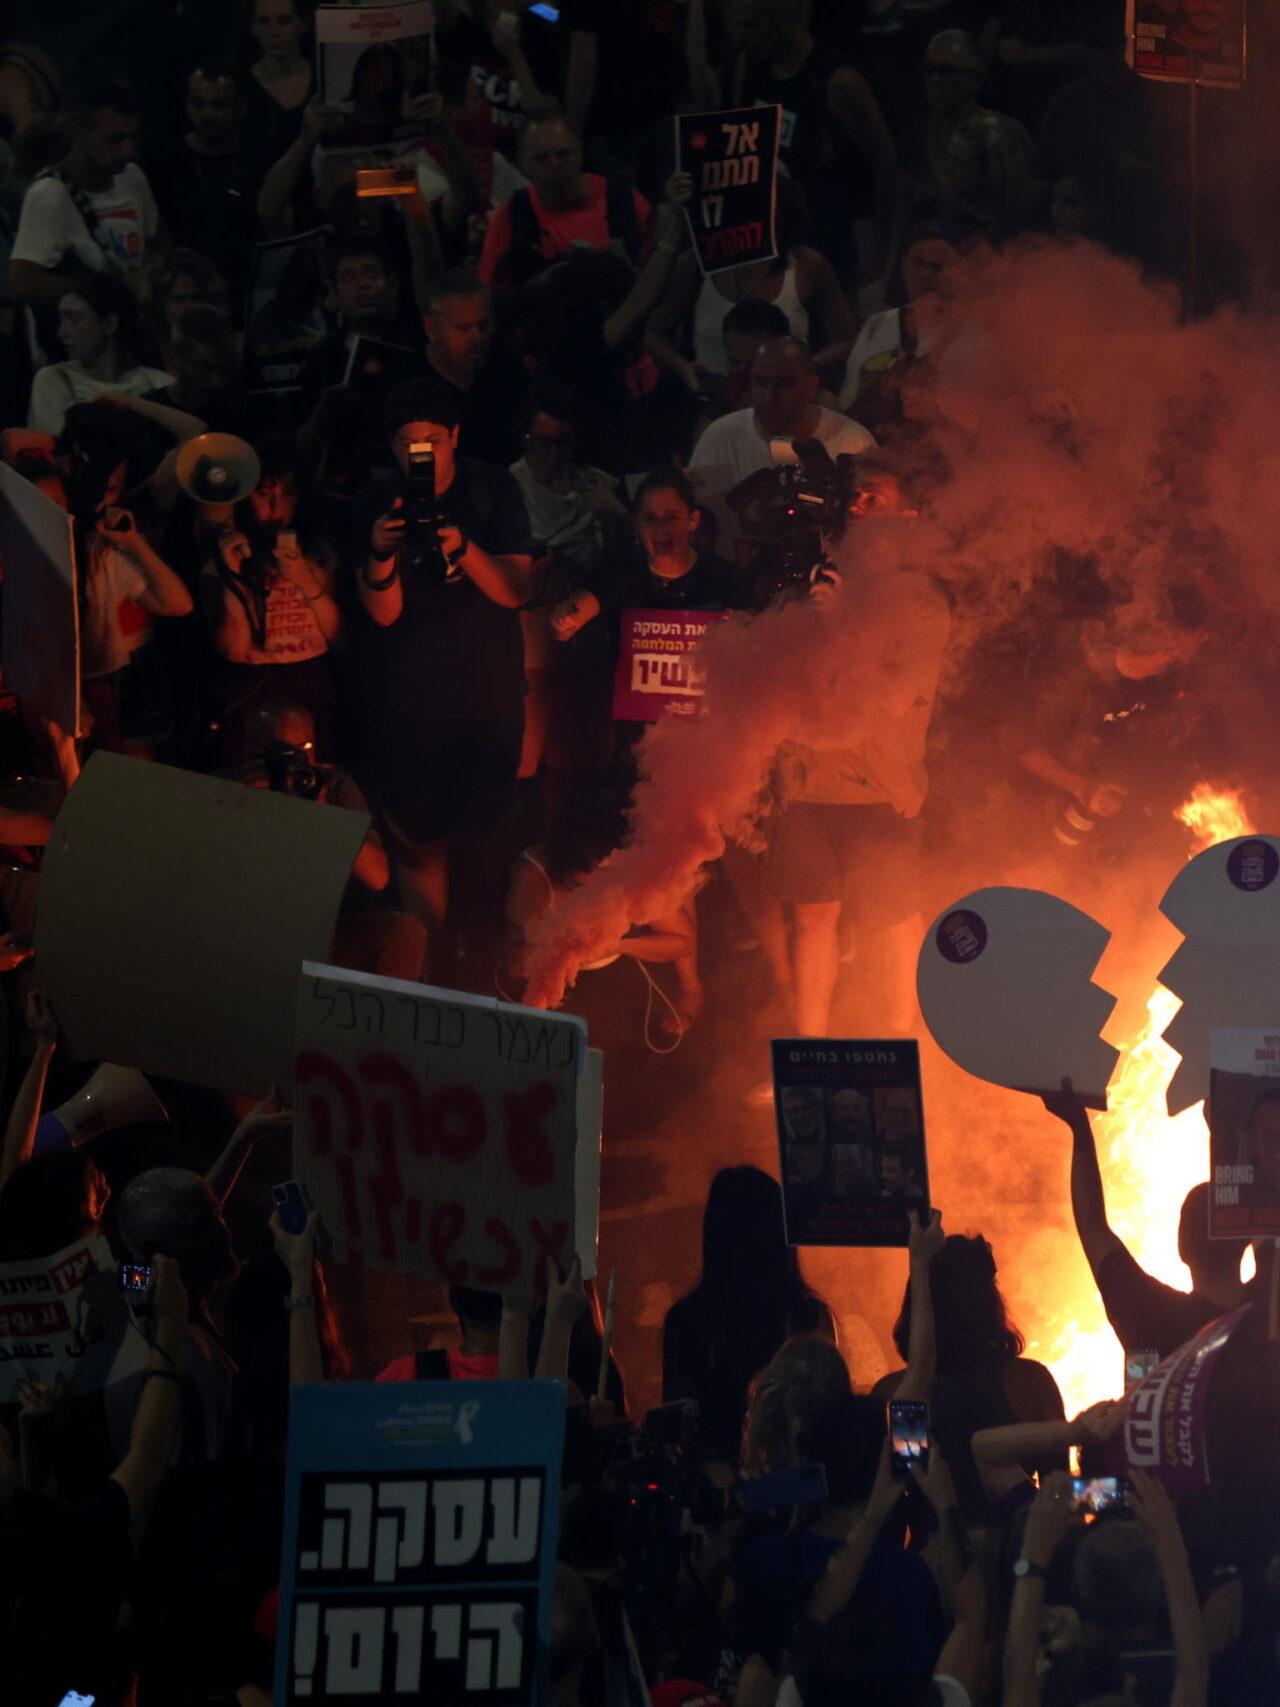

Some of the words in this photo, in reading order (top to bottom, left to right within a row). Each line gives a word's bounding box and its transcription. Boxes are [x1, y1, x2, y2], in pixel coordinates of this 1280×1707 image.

[721, 121, 762, 156] אל
[701, 192, 726, 228] לו
[631, 638, 685, 652] המלחמה
[633, 621, 682, 637] העסקה
[684, 622, 707, 636] את
[312, 977, 385, 1033] הכל
[399, 998, 466, 1049] כבר
[481, 1011, 579, 1070] נאמר
[789, 1051, 839, 1064] בחיים
[845, 1051, 897, 1064] נחטפו
[294, 1047, 558, 1200] עסקה
[1214, 1165, 1254, 1185] BRING
[1214, 1185, 1240, 1206] HIM
[54, 1252, 90, 1291] אין
[1179, 1382, 1197, 1412] את
[1177, 1414, 1196, 1467] לקבל
[299, 1476, 543, 1583] עסקה.
[293, 1600, 526, 1698] היום!
